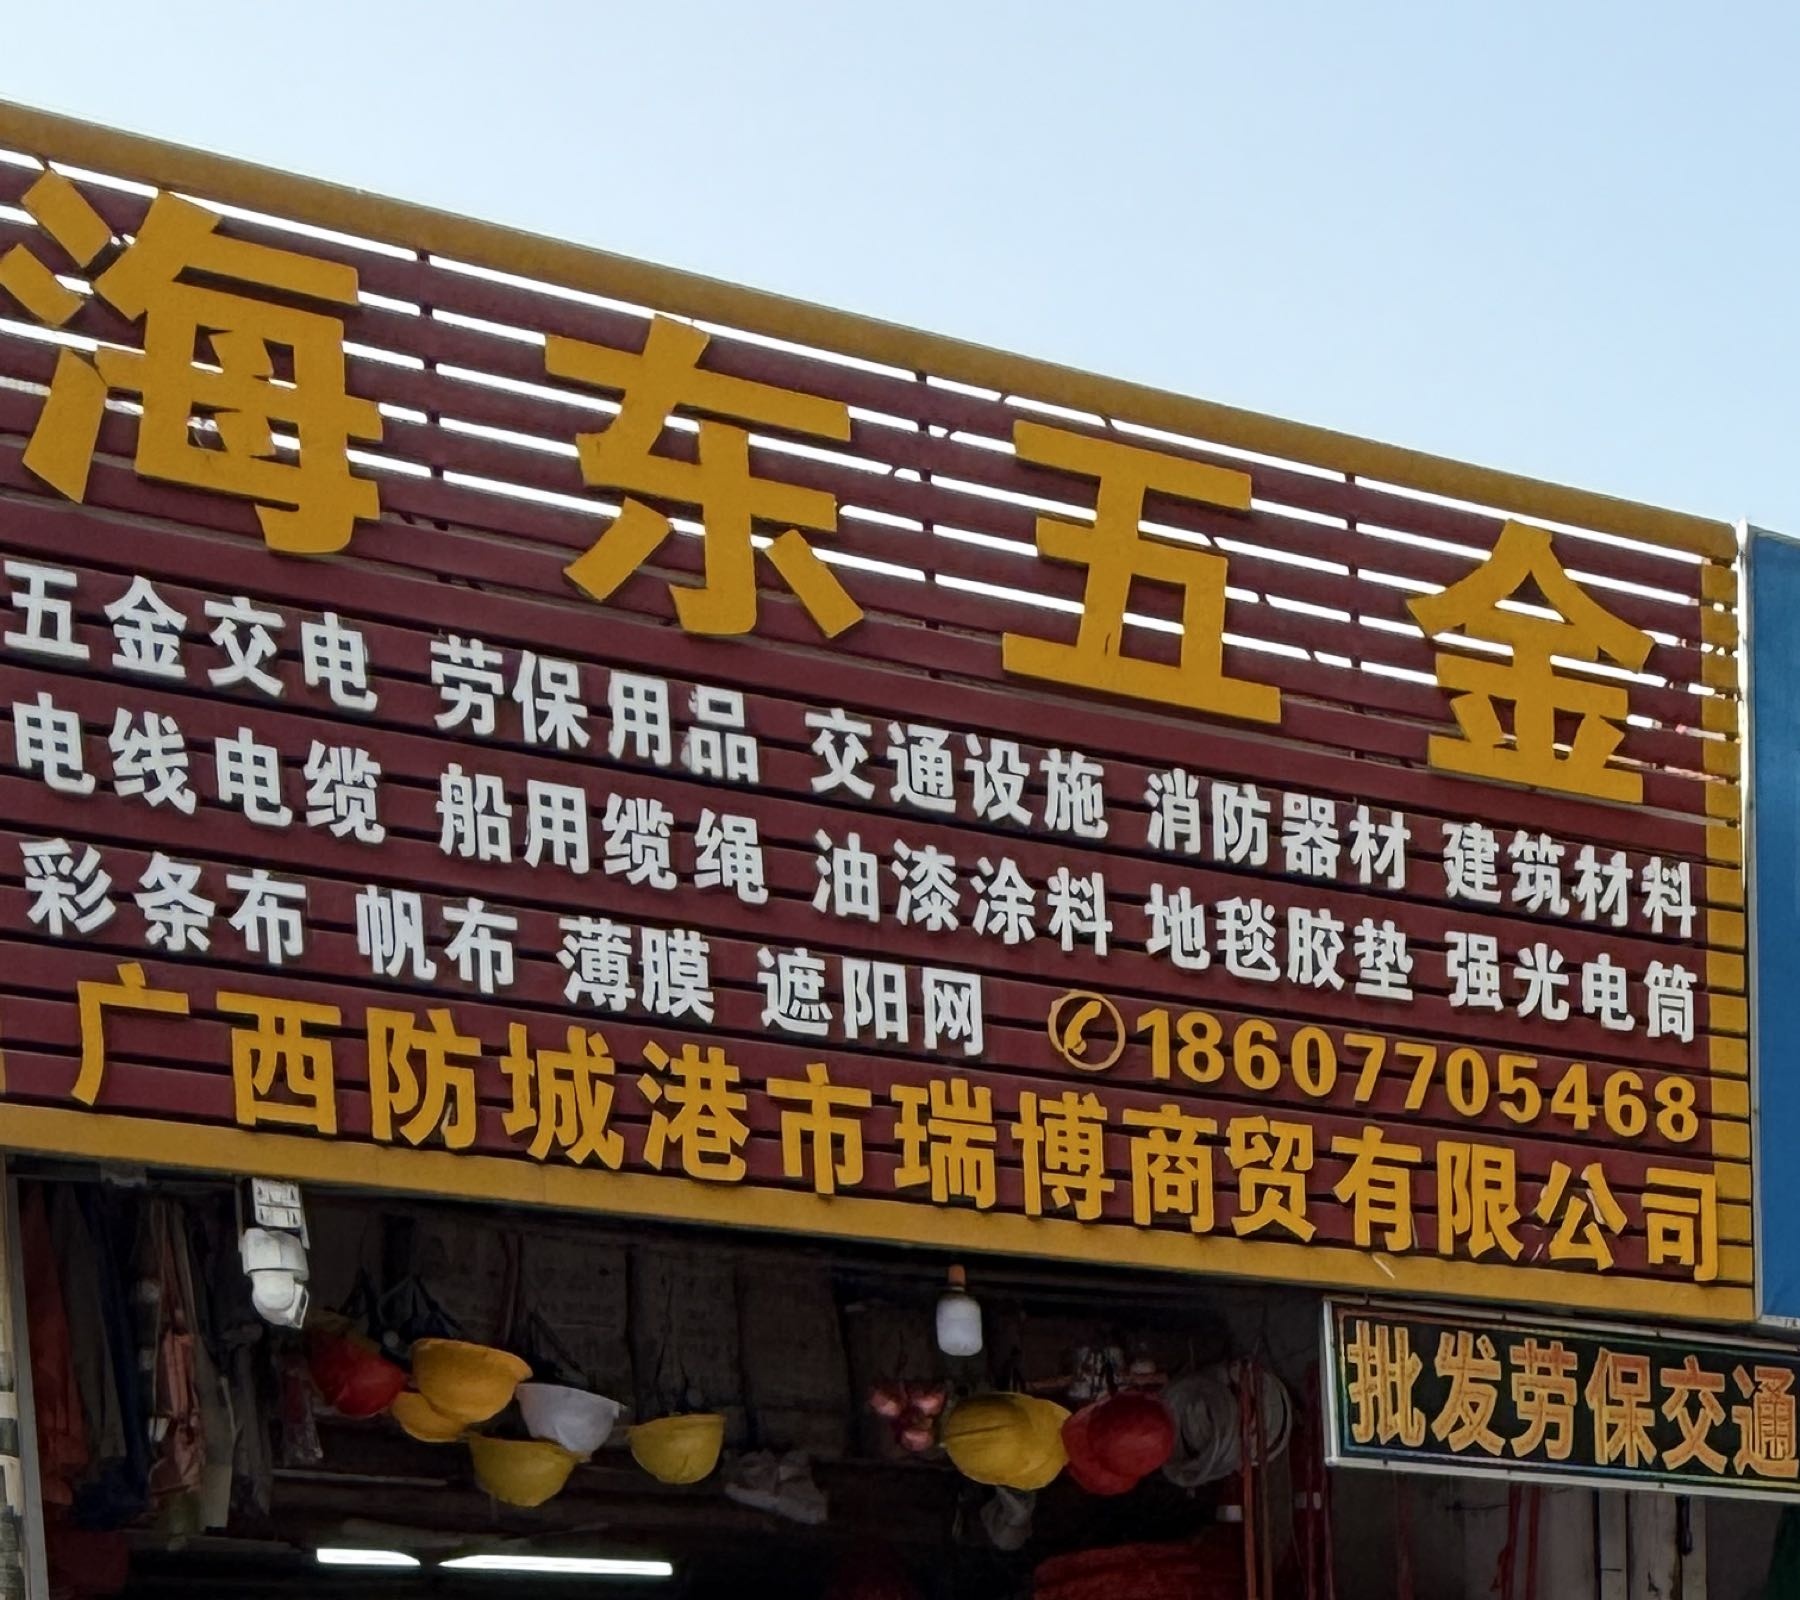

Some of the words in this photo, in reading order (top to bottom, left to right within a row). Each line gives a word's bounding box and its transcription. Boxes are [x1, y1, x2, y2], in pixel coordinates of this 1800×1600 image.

[0, 168, 1656, 804] 海东五金
[3, 559, 380, 714] 五金交电
[430, 634, 761, 785] 劳保用品
[803, 708, 1109, 841] 交通设施
[1143, 766, 1412, 891] 消防器材
[1441, 821, 1697, 939] 建筑材料
[12, 692, 387, 845] 电线电缆
[436, 763, 769, 905] 船用缆绳
[811, 829, 1113, 957] 油漆涂料
[1144, 883, 1414, 1002] 地毯胶垫
[1445, 930, 1698, 1044] 强光电筒
[22, 837, 308, 965] 彩条布
[356, 885, 519, 994] 帆布
[556, 917, 716, 1025] 薄膜
[757, 946, 985, 1057] 遮阳网
[1136, 1009, 1700, 1144] 18607705468
[72, 962, 1720, 1283] 广西防城港市瑞博商贸有限公司
